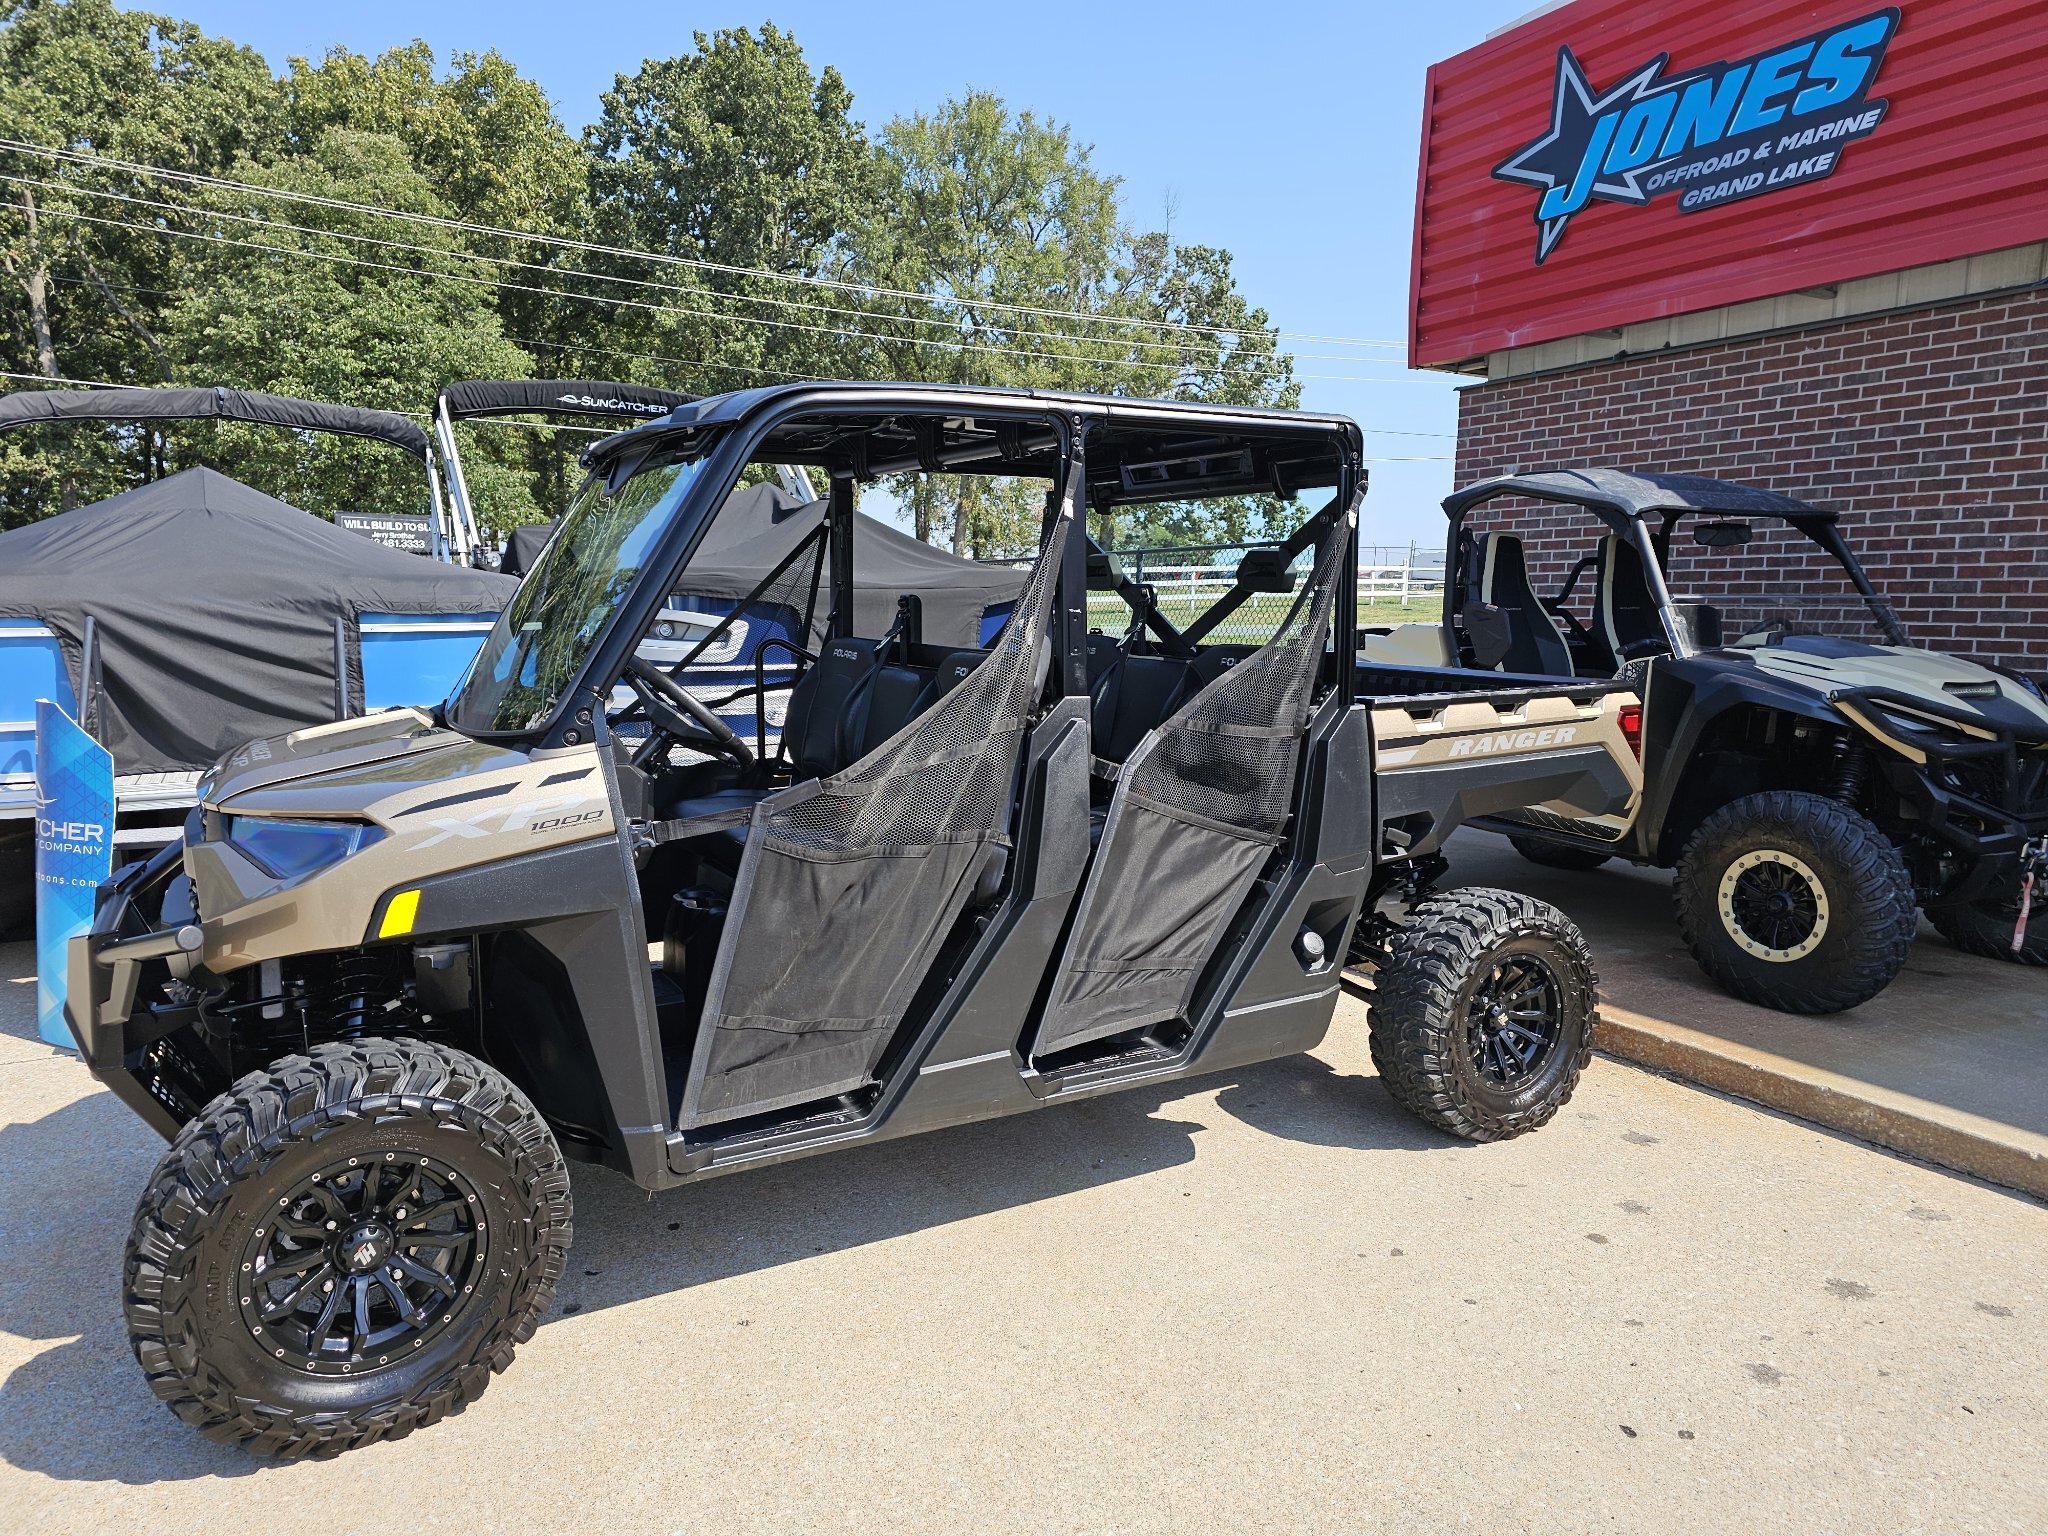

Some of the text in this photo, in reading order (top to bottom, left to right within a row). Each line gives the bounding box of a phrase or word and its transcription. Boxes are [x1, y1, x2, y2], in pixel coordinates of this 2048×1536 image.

[1538, 16, 1890, 220] JONES
[1646, 108, 1881, 191] OFFROAD & MARINE
[1682, 152, 1835, 207] GRAND LAKE
[343, 520, 370, 529] WILL
[371, 521, 403, 531] BUILD
[403, 522, 417, 531] TO
[371, 531, 389, 539] Jerry
[1448, 727, 1576, 757] RANGER
[405, 793, 589, 852] XP
[531, 810, 604, 831] 1000
[39, 840, 103, 856] COMPANY
